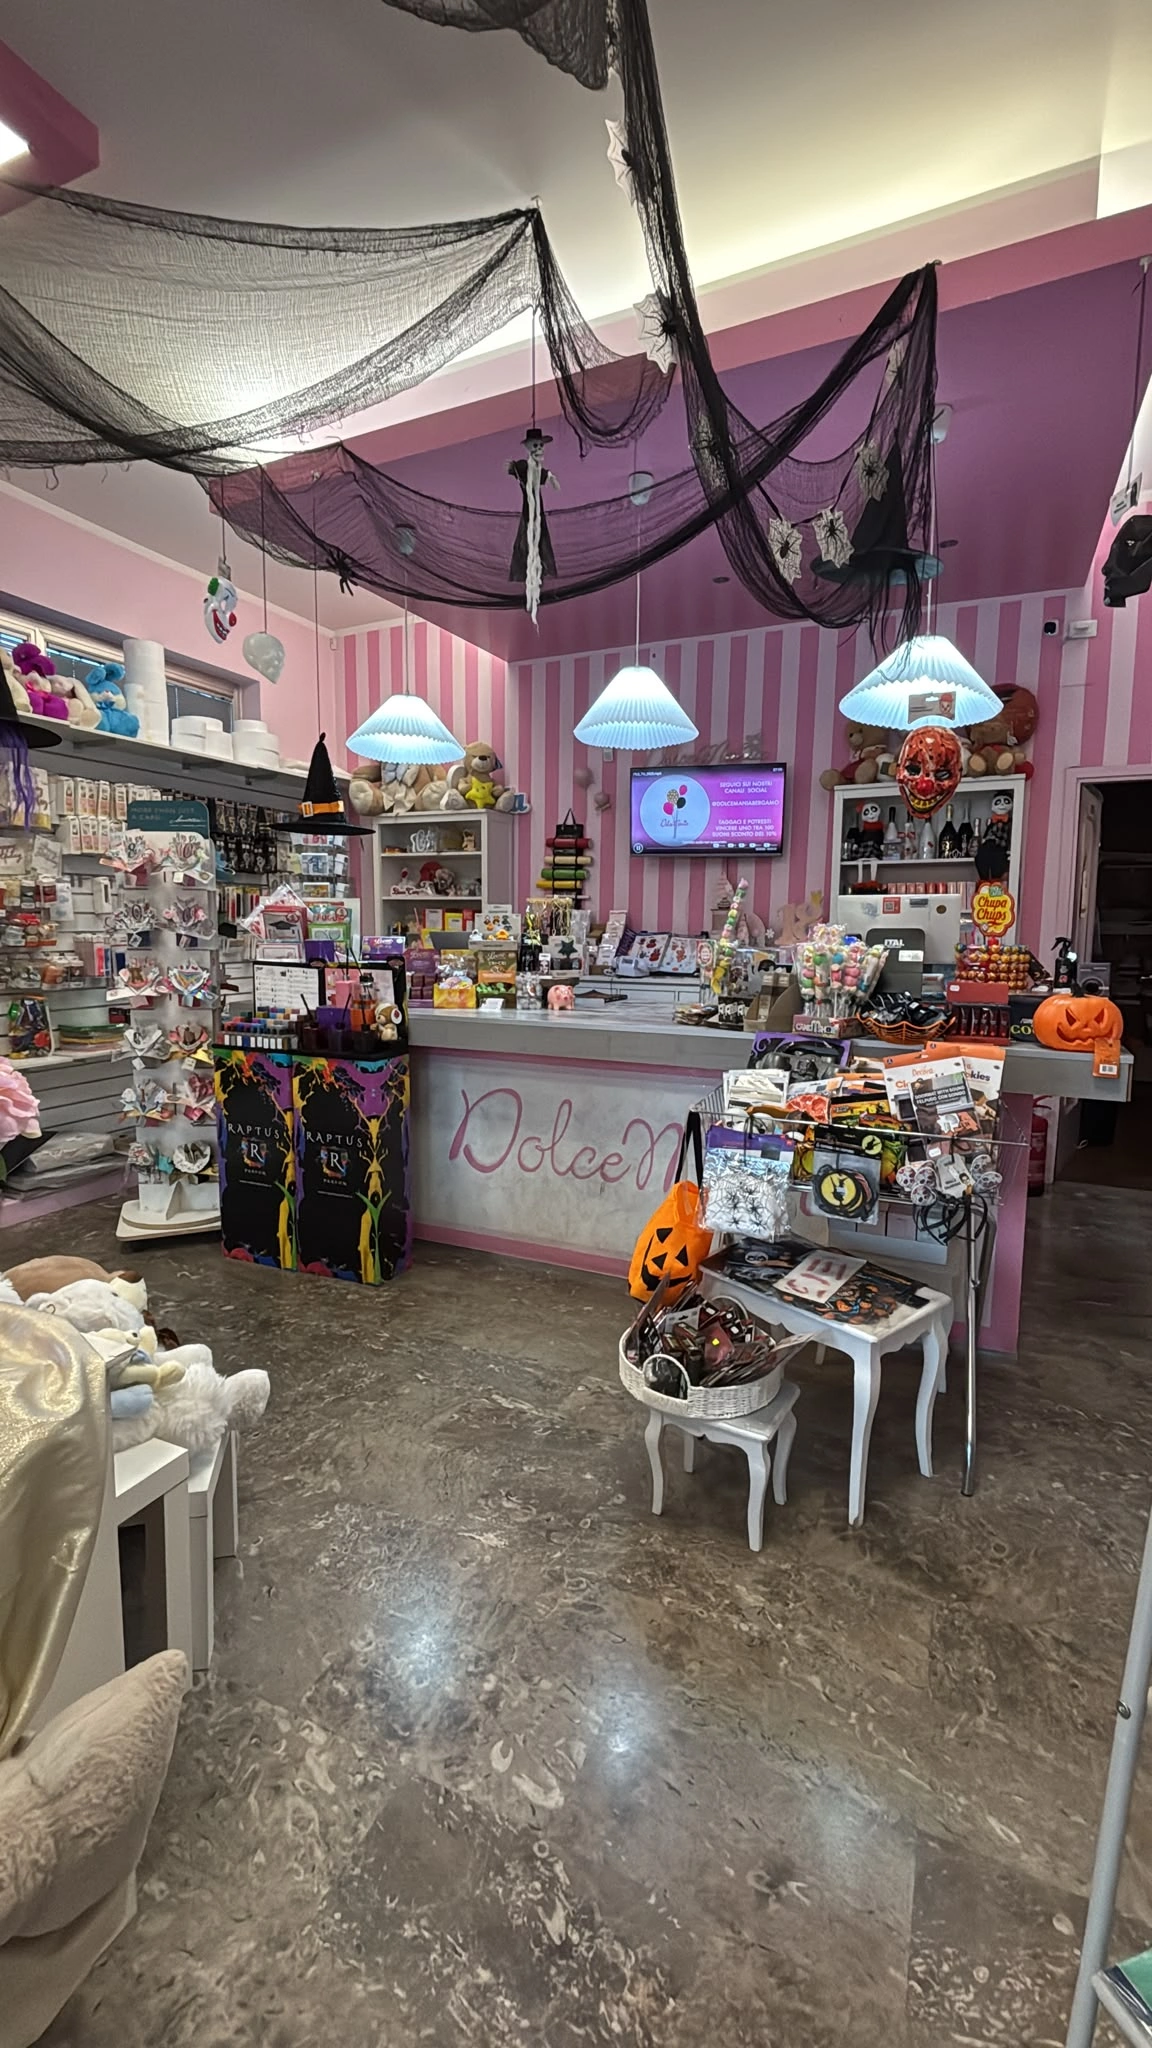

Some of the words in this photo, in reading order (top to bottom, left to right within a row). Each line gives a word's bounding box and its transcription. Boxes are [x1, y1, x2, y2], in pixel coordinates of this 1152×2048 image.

[977, 895, 1008, 911] Chupa
[976, 907, 1007, 923] Chups
[227, 1122, 280, 1140] RAPTUS
[306, 1130, 363, 1149] RAPTUS
[250, 1143, 266, 1163] R
[330, 1151, 346, 1173] R
